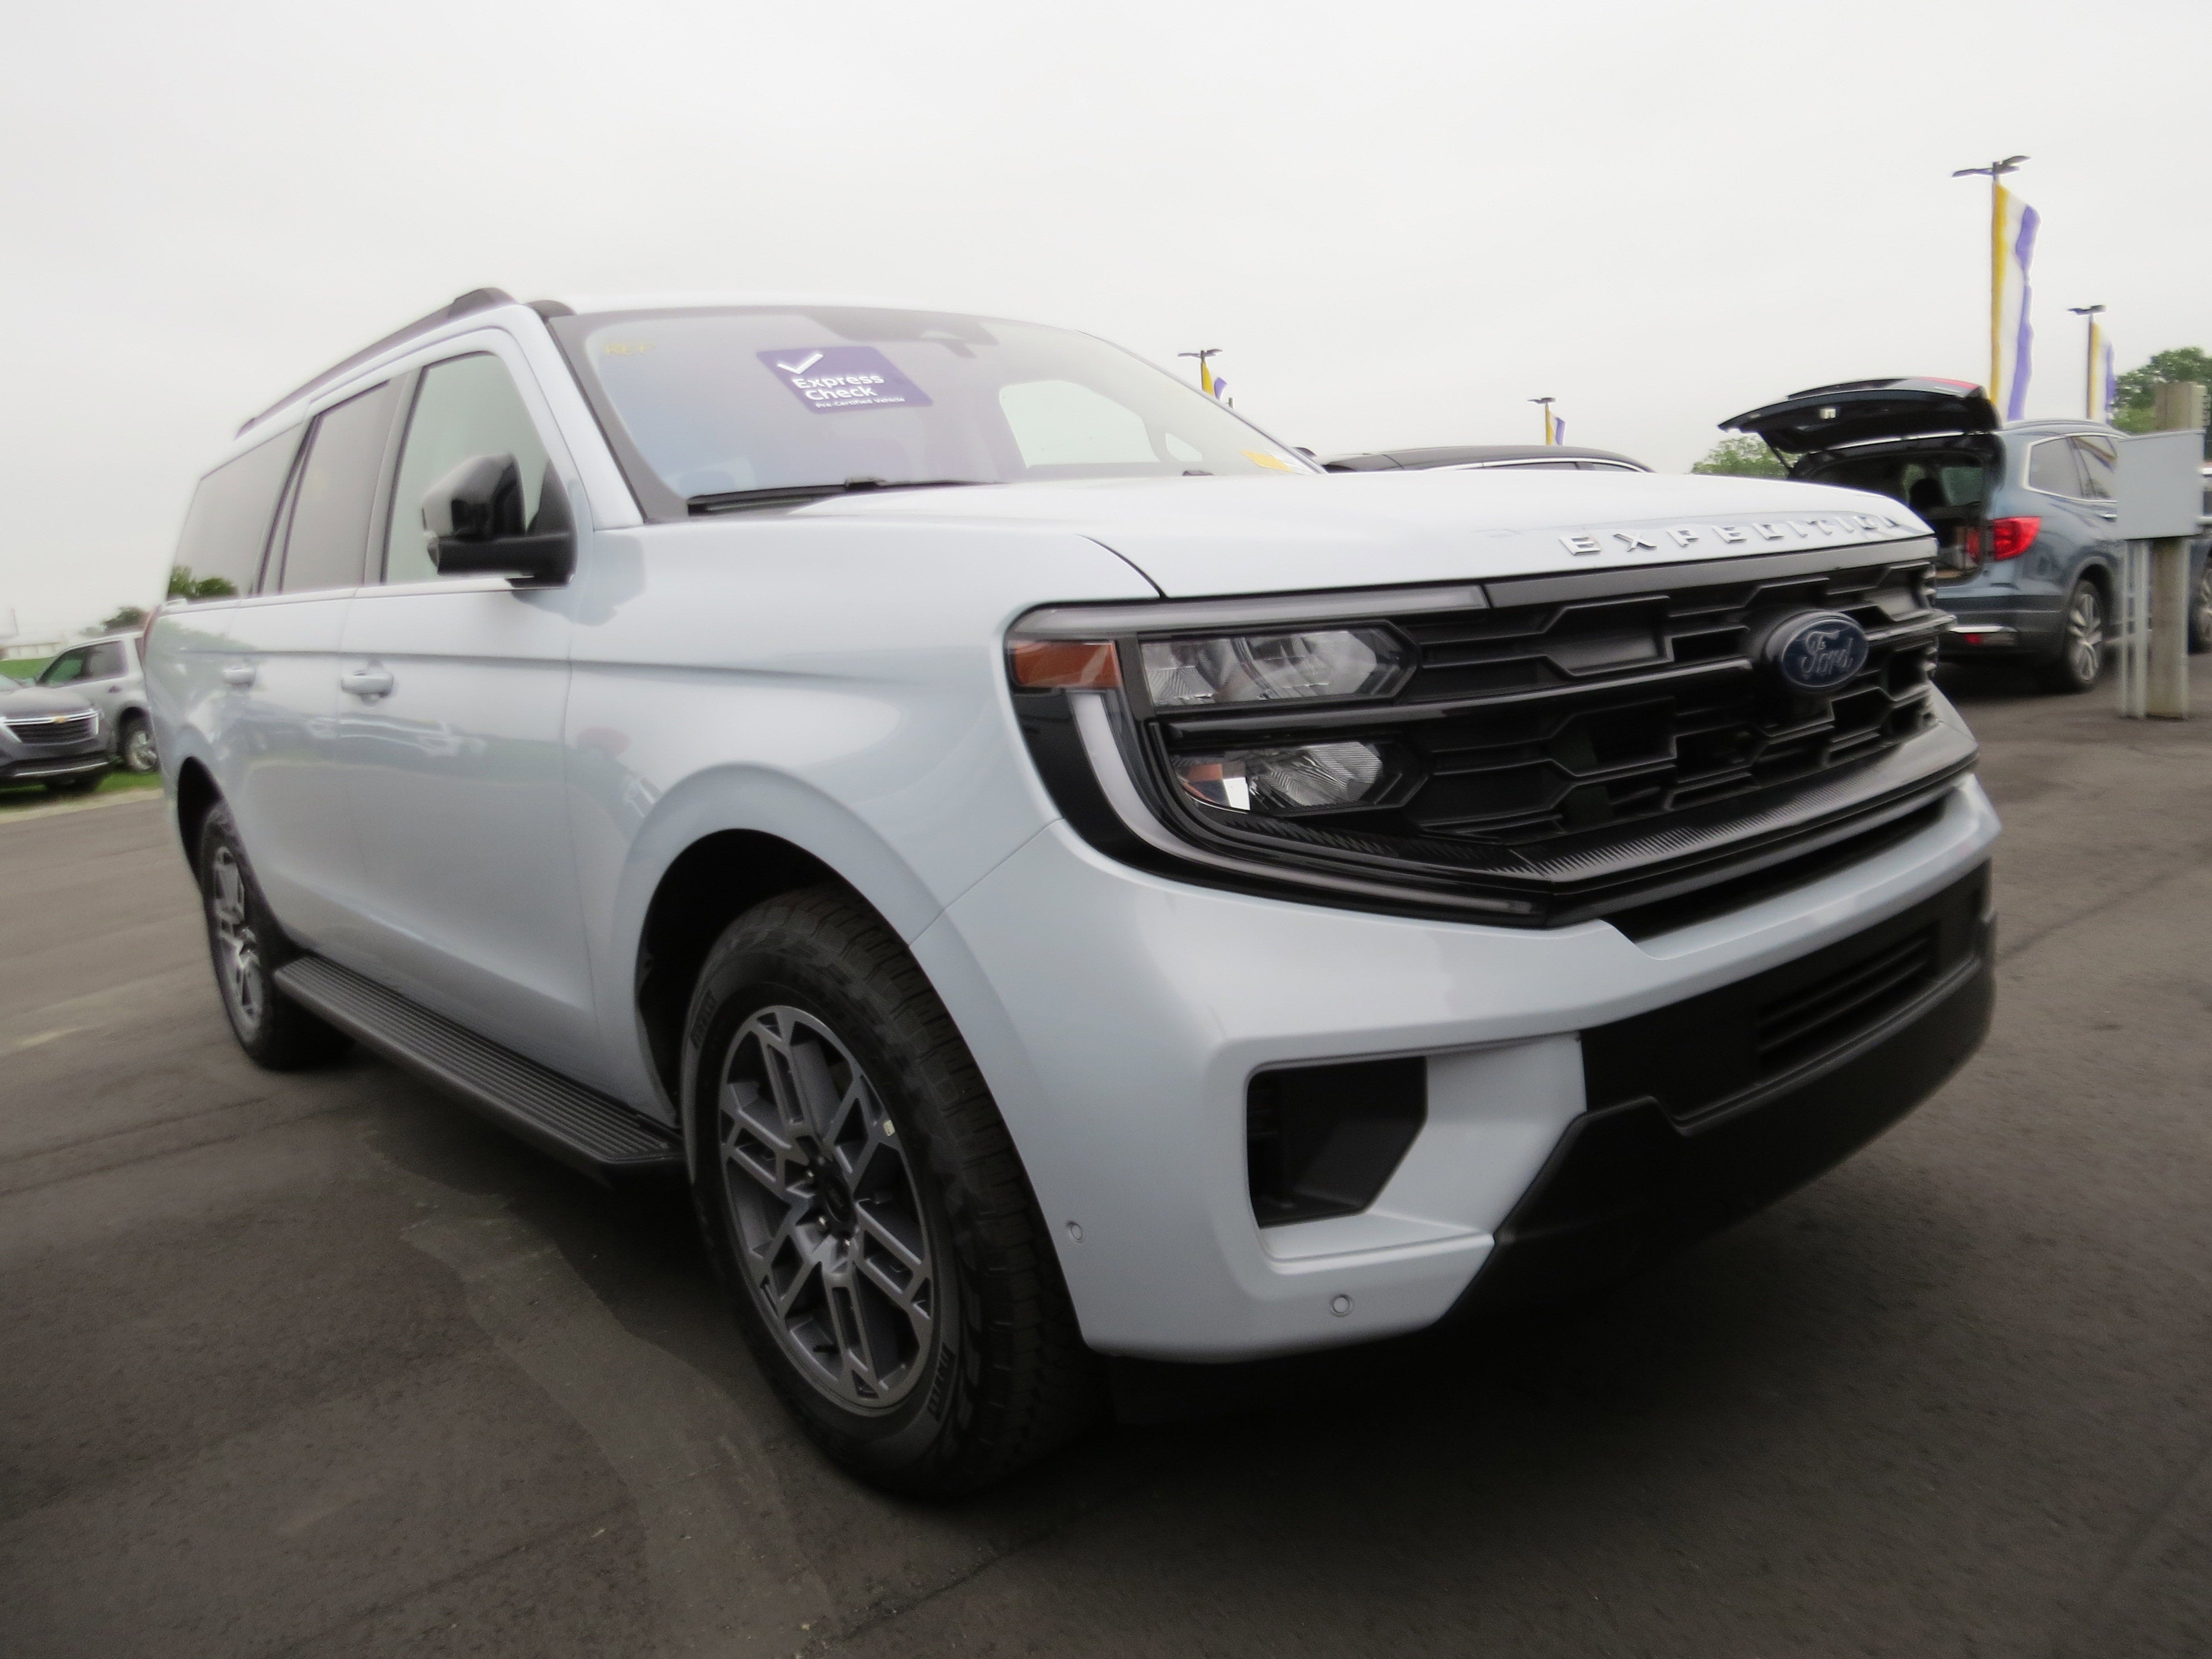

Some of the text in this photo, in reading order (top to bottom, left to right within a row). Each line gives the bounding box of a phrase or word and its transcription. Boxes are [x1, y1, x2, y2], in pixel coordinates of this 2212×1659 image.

[791, 375, 885, 389] Express
[805, 386, 878, 400] Check
[1557, 515, 1901, 556] EXPEDITION
[1799, 630, 1854, 680] Ford
